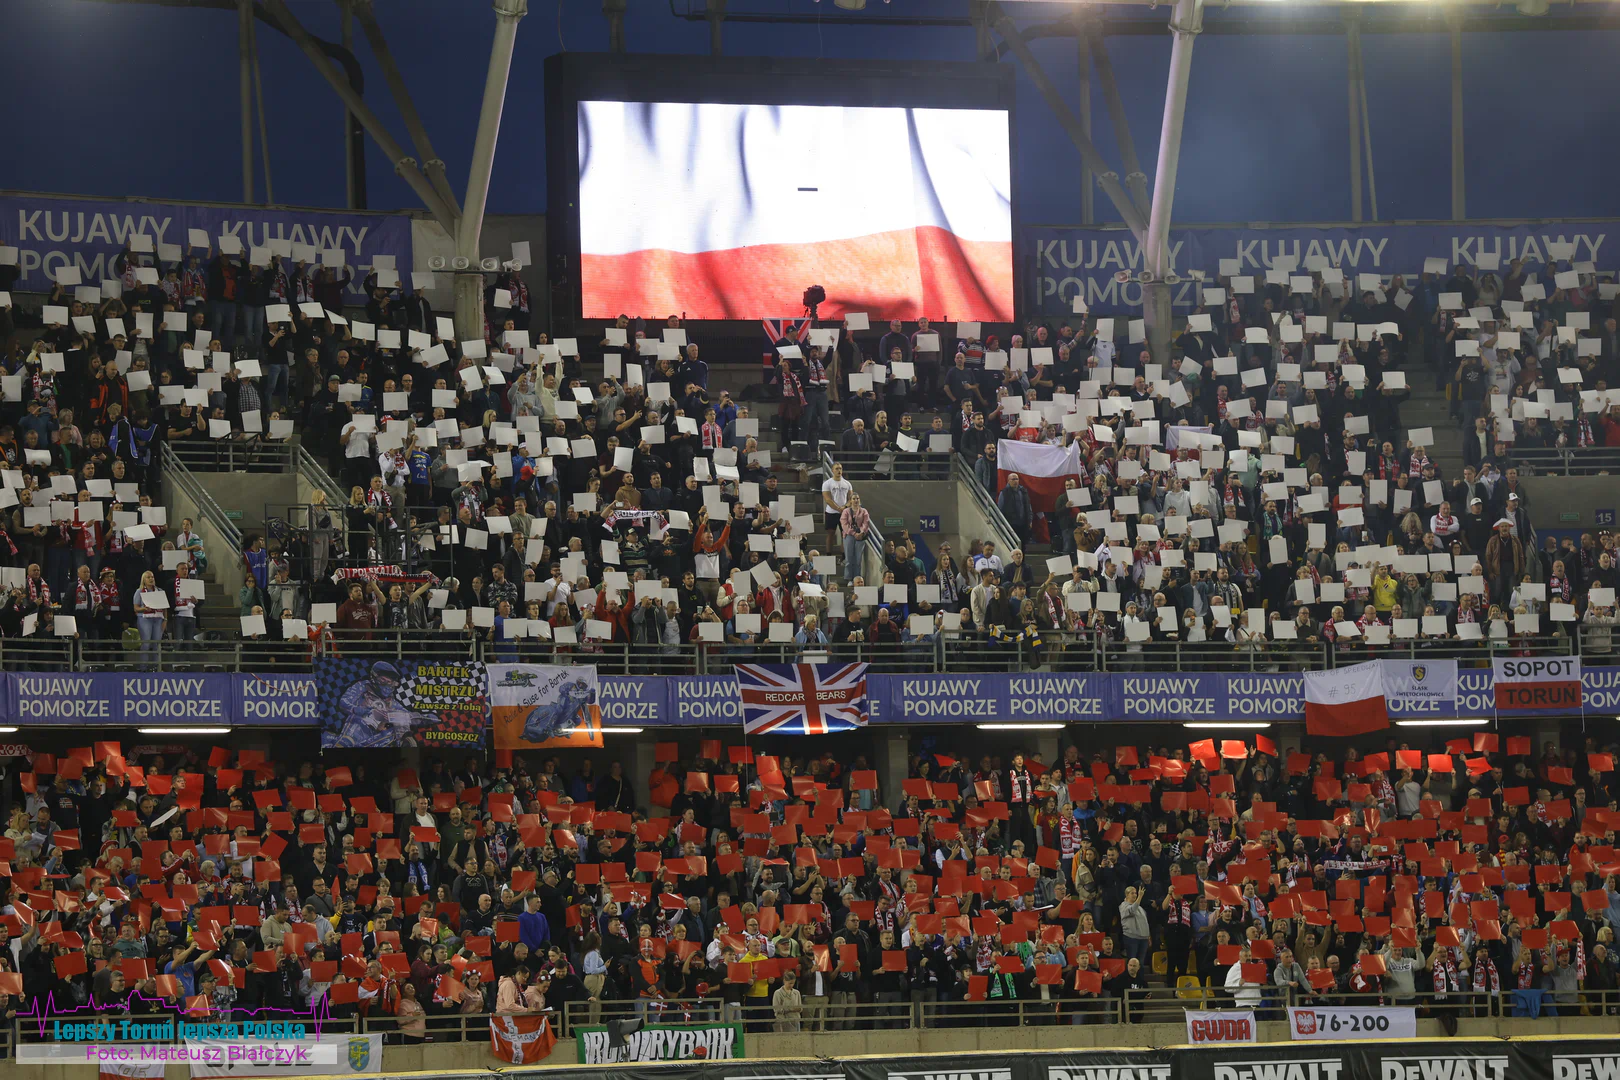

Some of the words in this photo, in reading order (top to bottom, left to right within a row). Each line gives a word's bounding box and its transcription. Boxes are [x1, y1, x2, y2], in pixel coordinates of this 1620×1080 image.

[1598, 512, 1612, 523] 15
[417, 665, 470, 678] BARTEK
[1503, 660, 1573, 677] SOPOT
[18, 678, 93, 696] KUJAWY
[123, 678, 205, 696] KUJAWY
[415, 684, 476, 697] MISTRZU
[678, 681, 740, 697] KUJAW
[903, 679, 981, 696] KUJAWY
[1009, 678, 1087, 694] KUJAWY
[1123, 678, 1200, 694] KUJAWY
[1228, 678, 1304, 694] KUJAWY
[1344, 684, 1356, 695] 95
[1506, 684, 1576, 704] TORUŃ
[765, 692, 805, 702] REDCAR
[816, 690, 846, 700] BEARS
[19, 699, 110, 717] POMORZE
[123, 699, 221, 717] POMORZE
[243, 700, 321, 718] POMOR
[414, 701, 450, 711] Zawsze
[458, 702, 481, 714] Tobą
[904, 699, 997, 716] POMORZE
[1010, 698, 1102, 715] POMORZE
[1124, 698, 1215, 714] POMORZE
[425, 731, 479, 743] BYDGOSZCZ
[1191, 1019, 1250, 1041] GWDA
[1316, 1013, 1389, 1032] 76-200
[650, 1027, 735, 1062] RYBNIK
